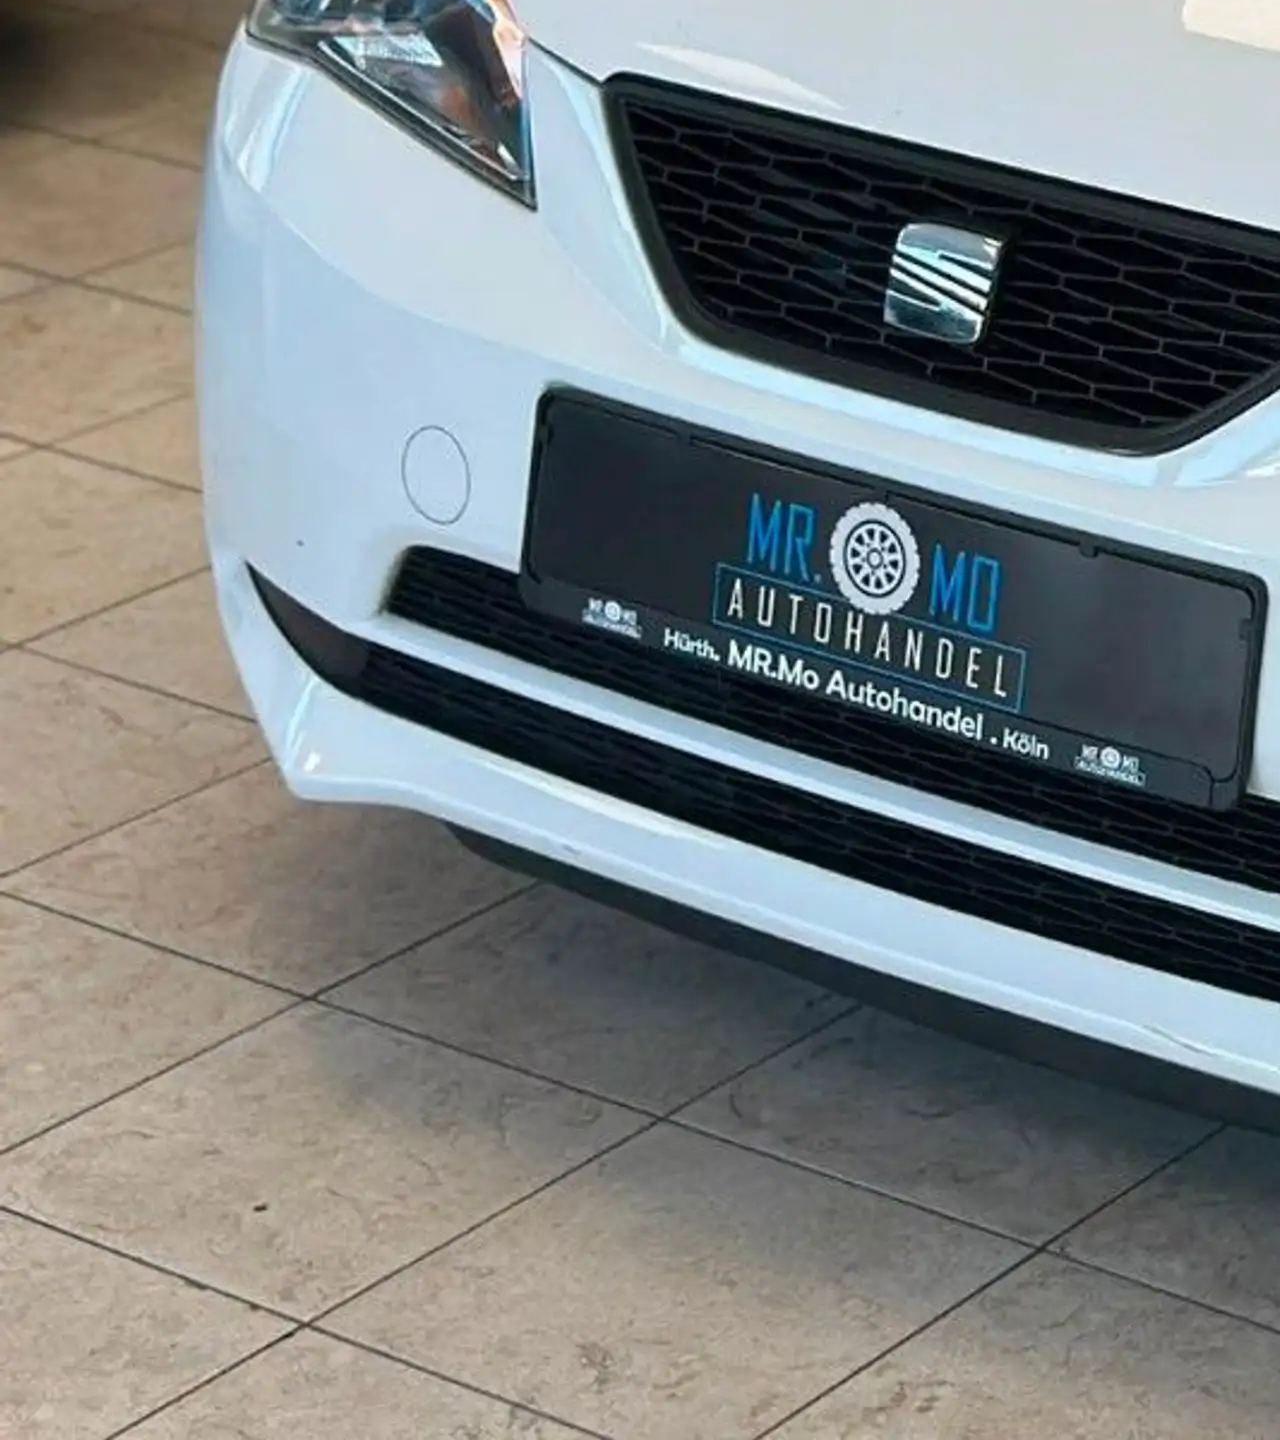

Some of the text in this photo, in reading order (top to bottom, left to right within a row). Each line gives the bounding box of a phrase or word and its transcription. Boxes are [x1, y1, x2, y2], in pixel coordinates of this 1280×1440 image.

[727, 577, 1008, 698] AUTOHANDEL
[929, 543, 1000, 632] MO
[727, 638, 820, 691] MR.Mo
[825, 668, 984, 740] Autohandel
[1002, 727, 1050, 760] Köln
